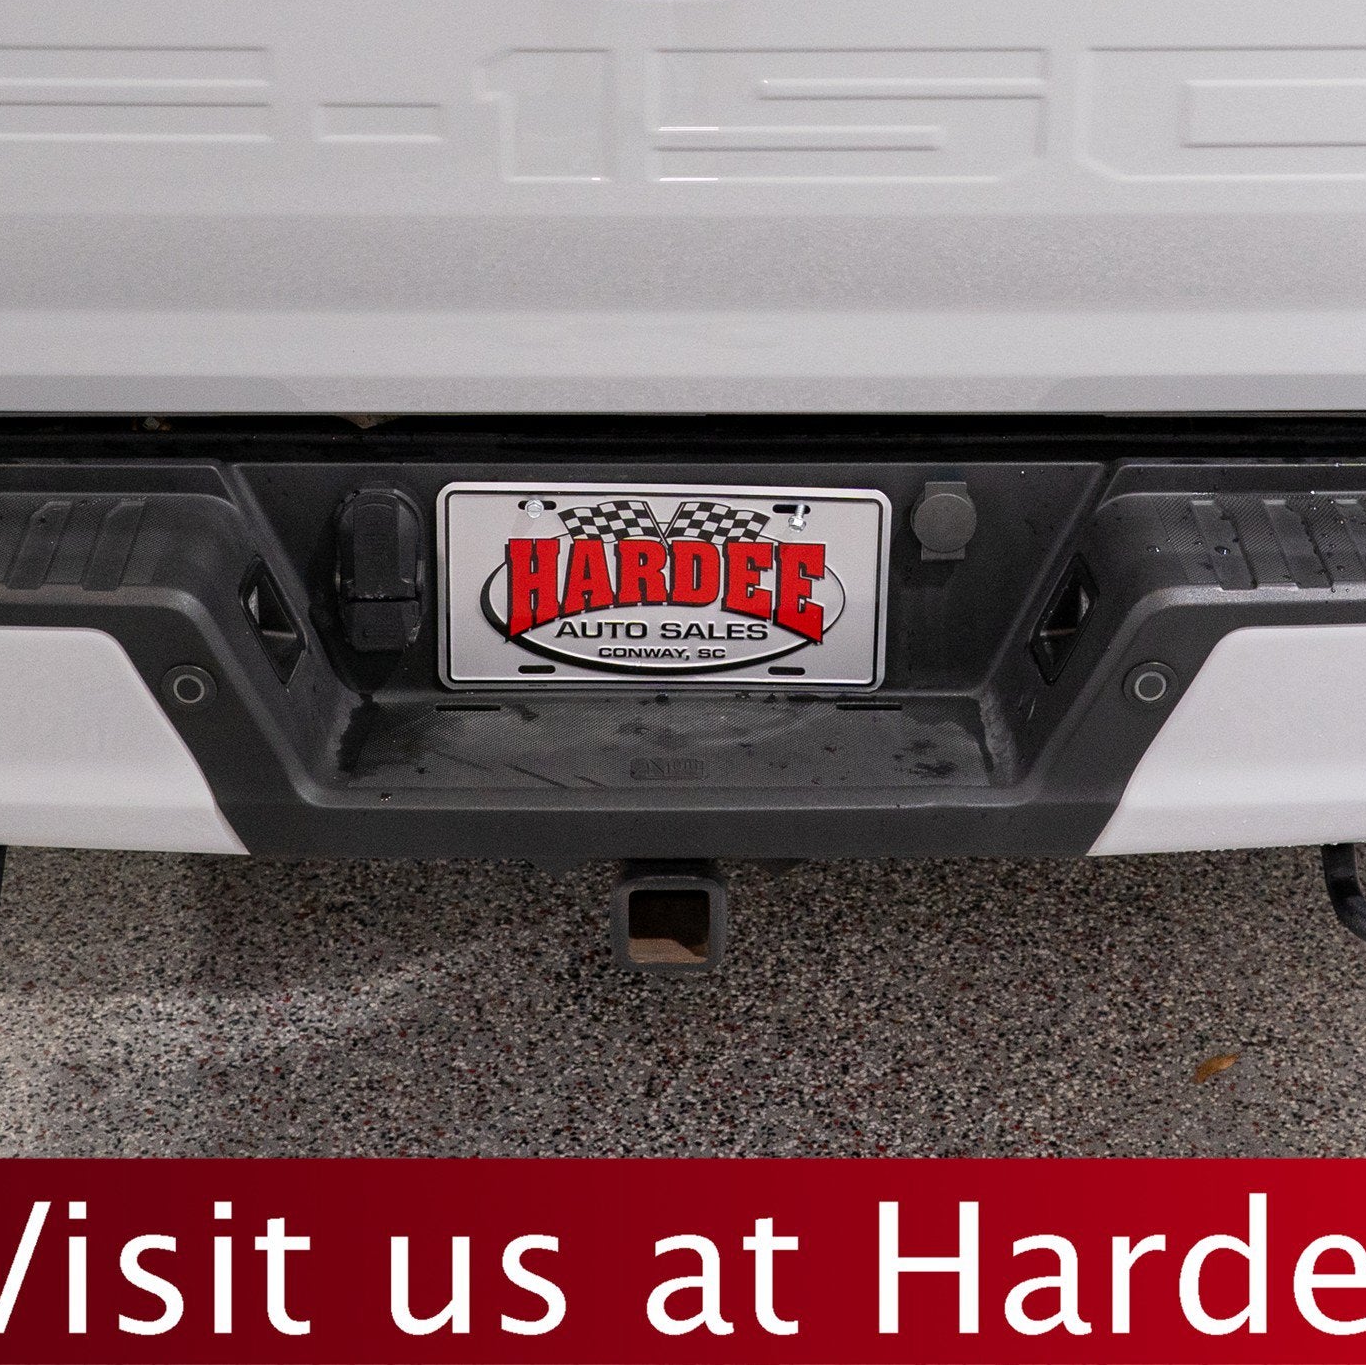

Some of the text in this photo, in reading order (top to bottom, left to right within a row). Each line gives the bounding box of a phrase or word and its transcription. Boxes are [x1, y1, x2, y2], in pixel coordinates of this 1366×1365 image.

[505, 538, 826, 645] HARDEE
[554, 621, 769, 641] AUTO SALES
[598, 647, 726, 660] CONWAY, SC
